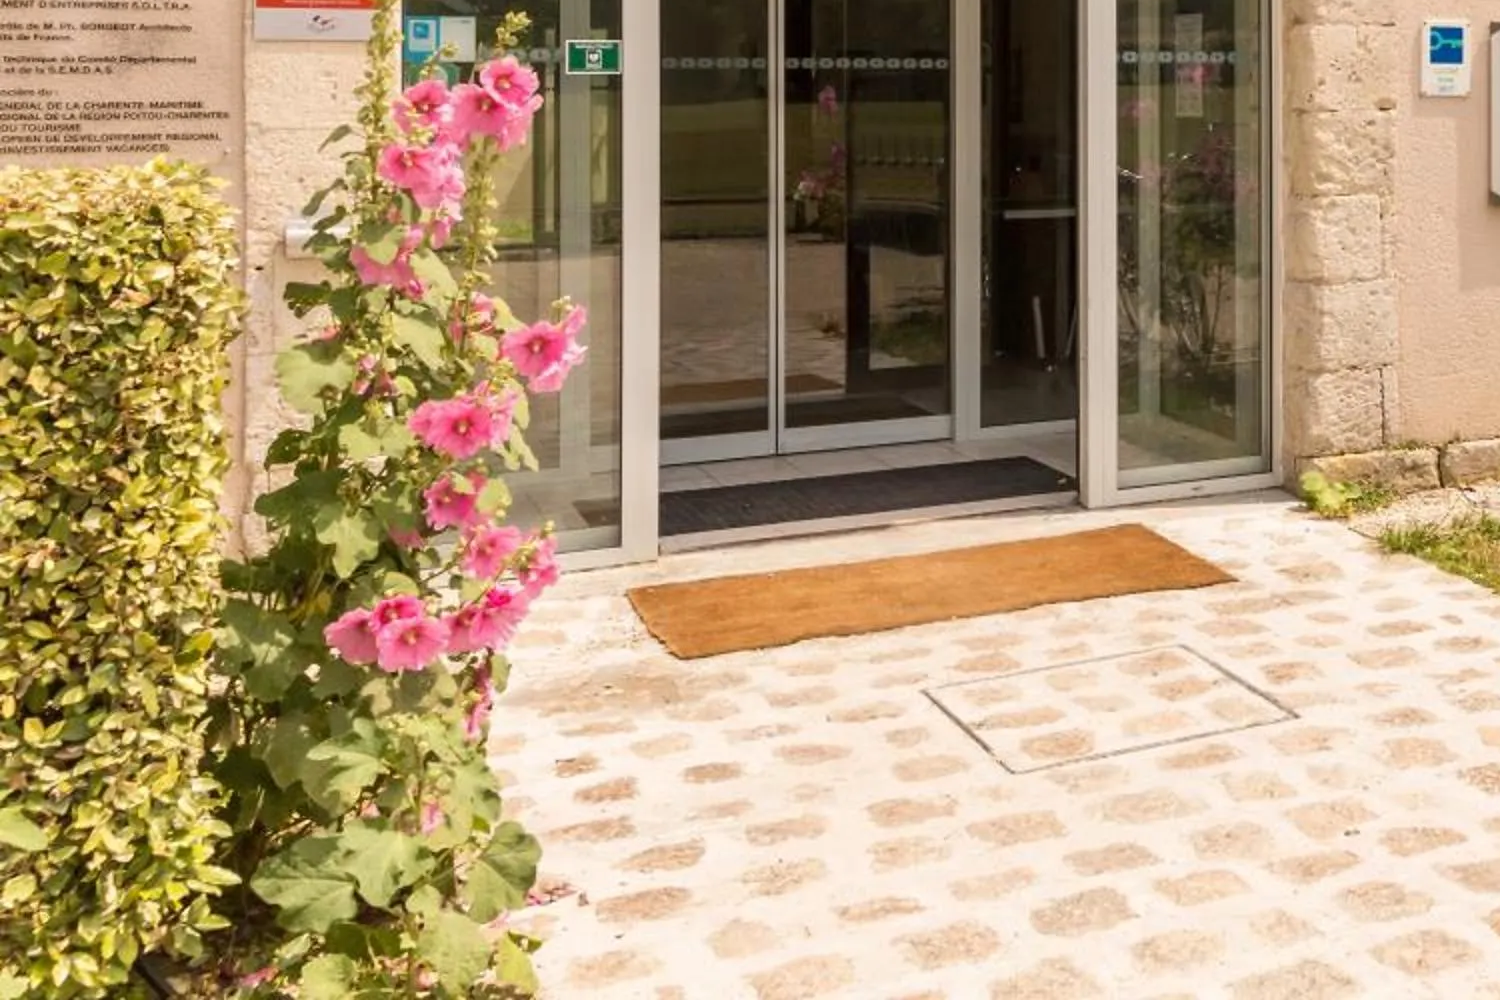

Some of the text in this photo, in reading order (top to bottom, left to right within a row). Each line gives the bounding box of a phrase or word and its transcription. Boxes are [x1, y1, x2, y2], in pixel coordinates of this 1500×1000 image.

[47, 101, 63, 111] DE
[65, 101, 81, 111] LA
[61, 112, 76, 121] LA
[22, 123, 81, 133] TOURISME
